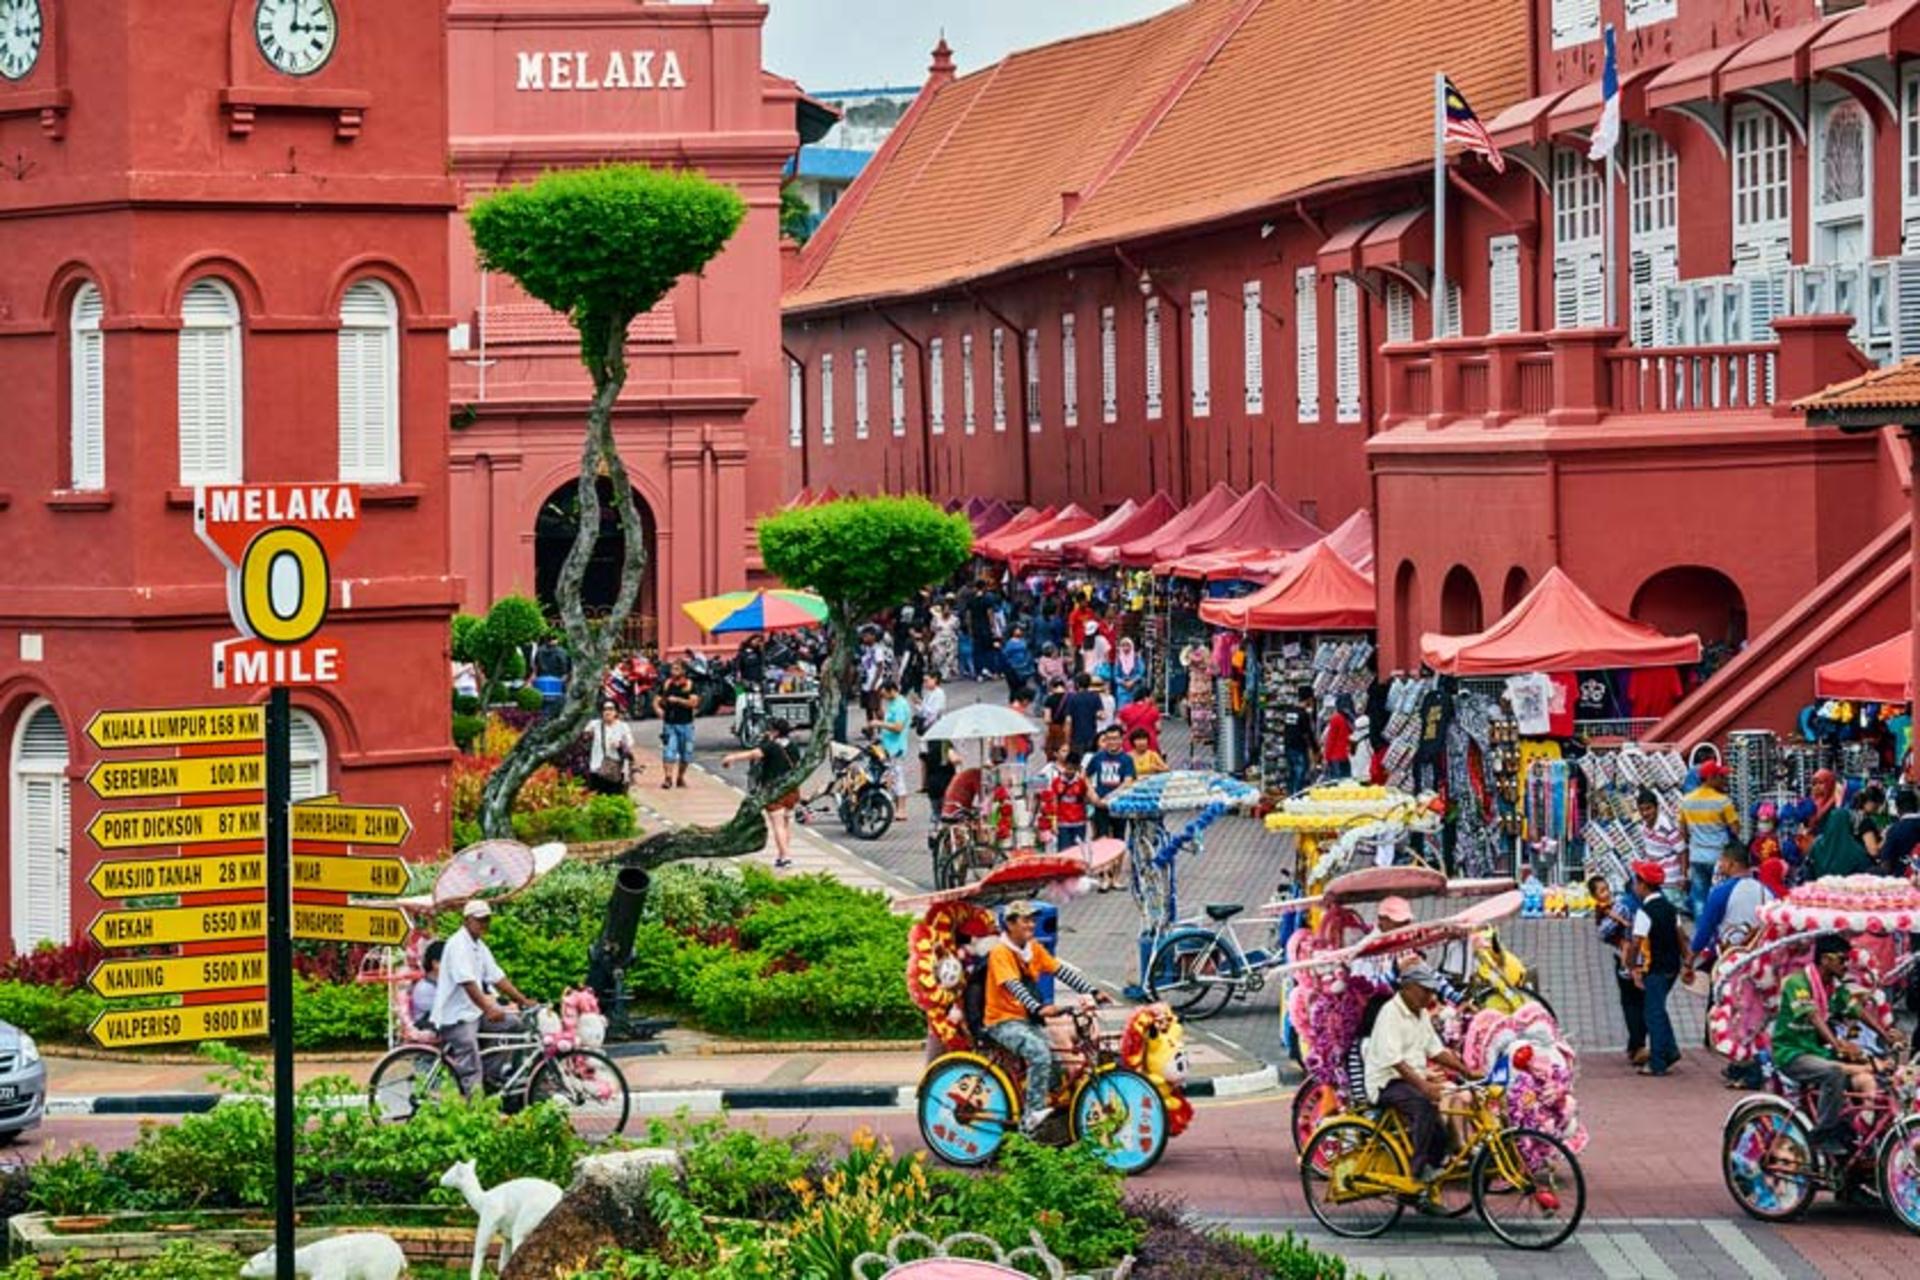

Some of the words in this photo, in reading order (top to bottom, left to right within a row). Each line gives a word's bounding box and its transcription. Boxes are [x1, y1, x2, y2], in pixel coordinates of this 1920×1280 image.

[515, 51, 686, 90] MELAKA
[211, 488, 356, 522] MELAKA
[232, 648, 339, 685] MILE
[102, 718, 146, 741] KUALA
[150, 716, 207, 738] LUMPUR
[210, 714, 235, 735] 168
[239, 713, 259, 733] KM
[103, 767, 178, 791] SEREMBAN
[210, 764, 236, 785] 100
[239, 763, 260, 783] KM
[104, 818, 139, 840] PORT
[143, 815, 203, 838] DICKSON
[219, 813, 236, 833] 87
[239, 811, 261, 832] KM
[384, 816, 399, 837] KM
[104, 867, 155, 890] MASJID
[159, 864, 203, 887] TANAH
[219, 862, 236, 883] 28
[240, 861, 261, 882] KM
[385, 866, 399, 887] KM
[105, 917, 154, 940] MEKAH
[203, 911, 237, 933] 6550
[241, 909, 262, 931] KM
[386, 916, 399, 937] KM
[106, 966, 164, 991] NANJING
[203, 961, 238, 983] 5500
[241, 959, 262, 981] KM
[106, 1015, 182, 1040] VALPERISO
[203, 1010, 239, 1032] 9800
[241, 1008, 263, 1030] KM
